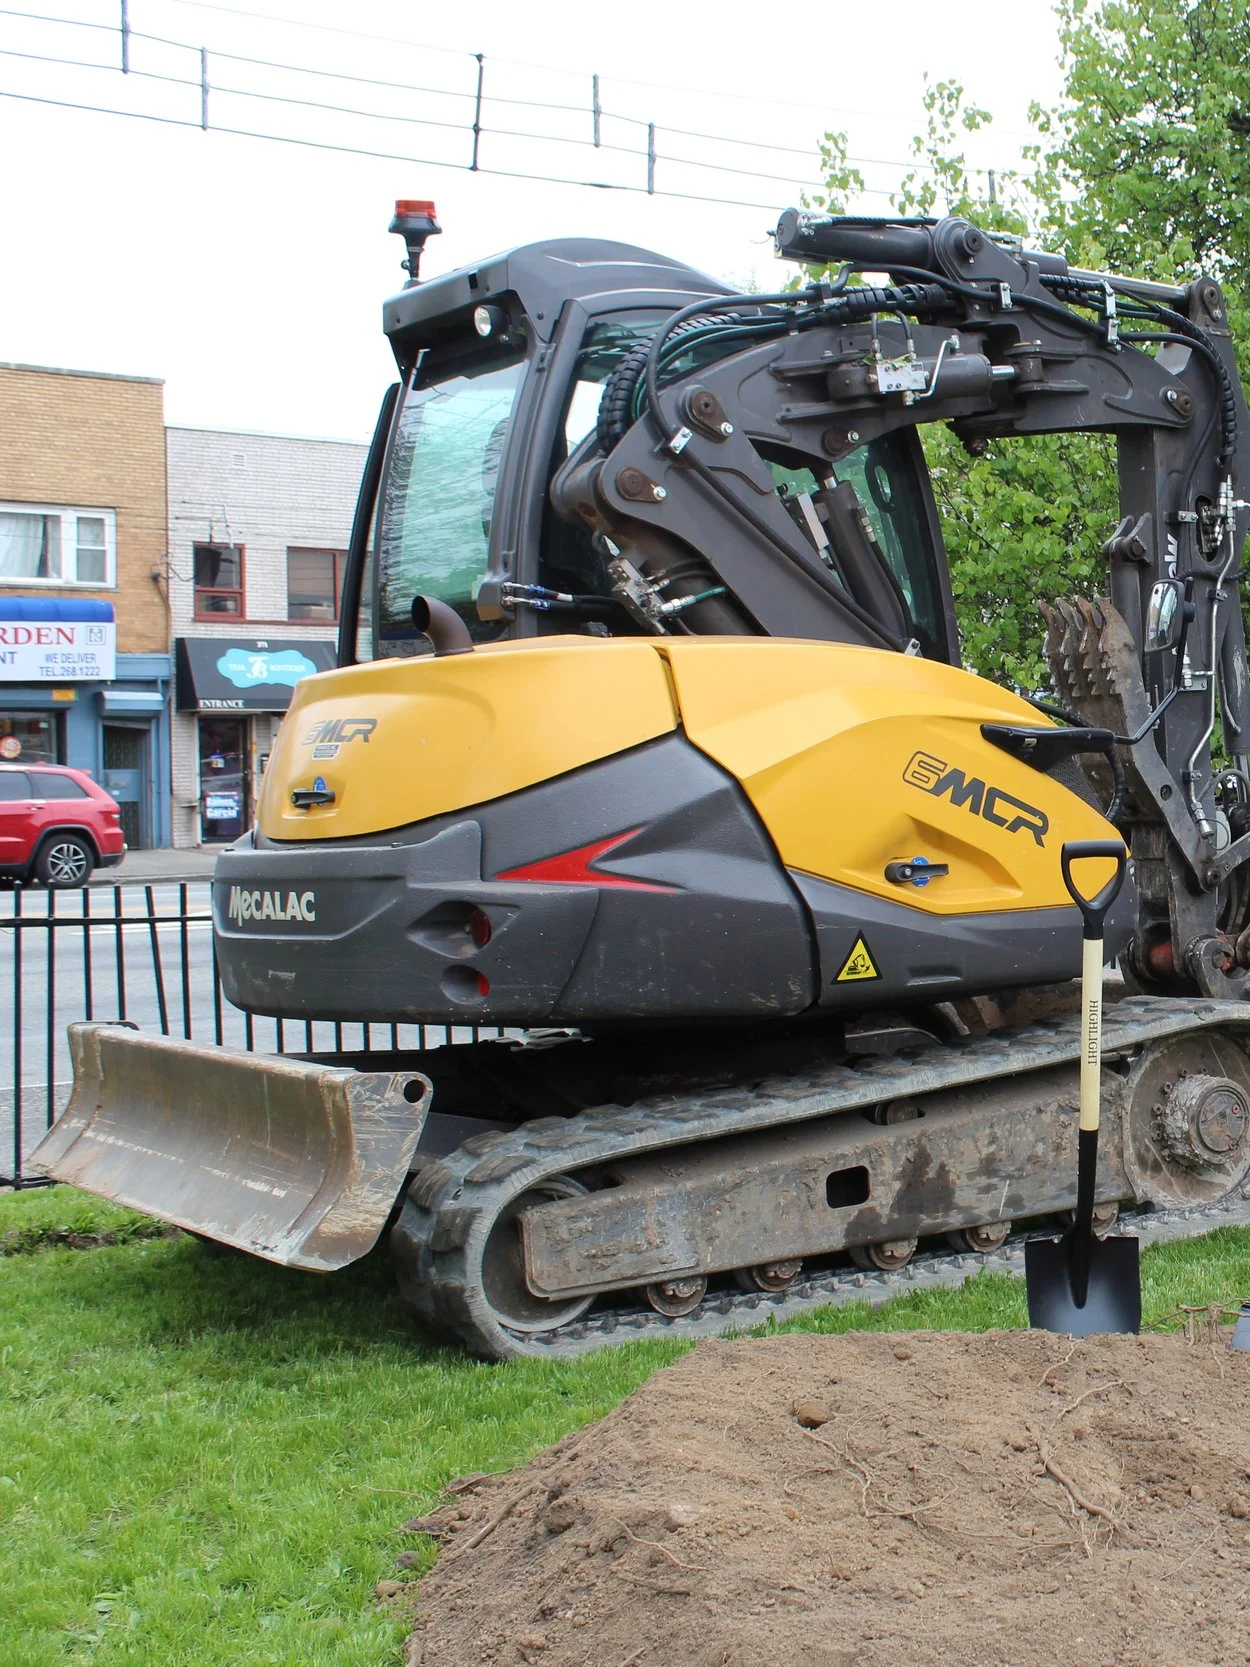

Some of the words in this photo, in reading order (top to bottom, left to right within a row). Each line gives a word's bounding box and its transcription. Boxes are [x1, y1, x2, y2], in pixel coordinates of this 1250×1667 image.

[45, 652, 59, 664] WE
[61, 652, 97, 664] DELIVER
[199, 700, 245, 709] ENTRANCE
[902, 750, 1049, 848] 6MCR
[1086, 999, 1100, 1066] HIGHLIGHT
